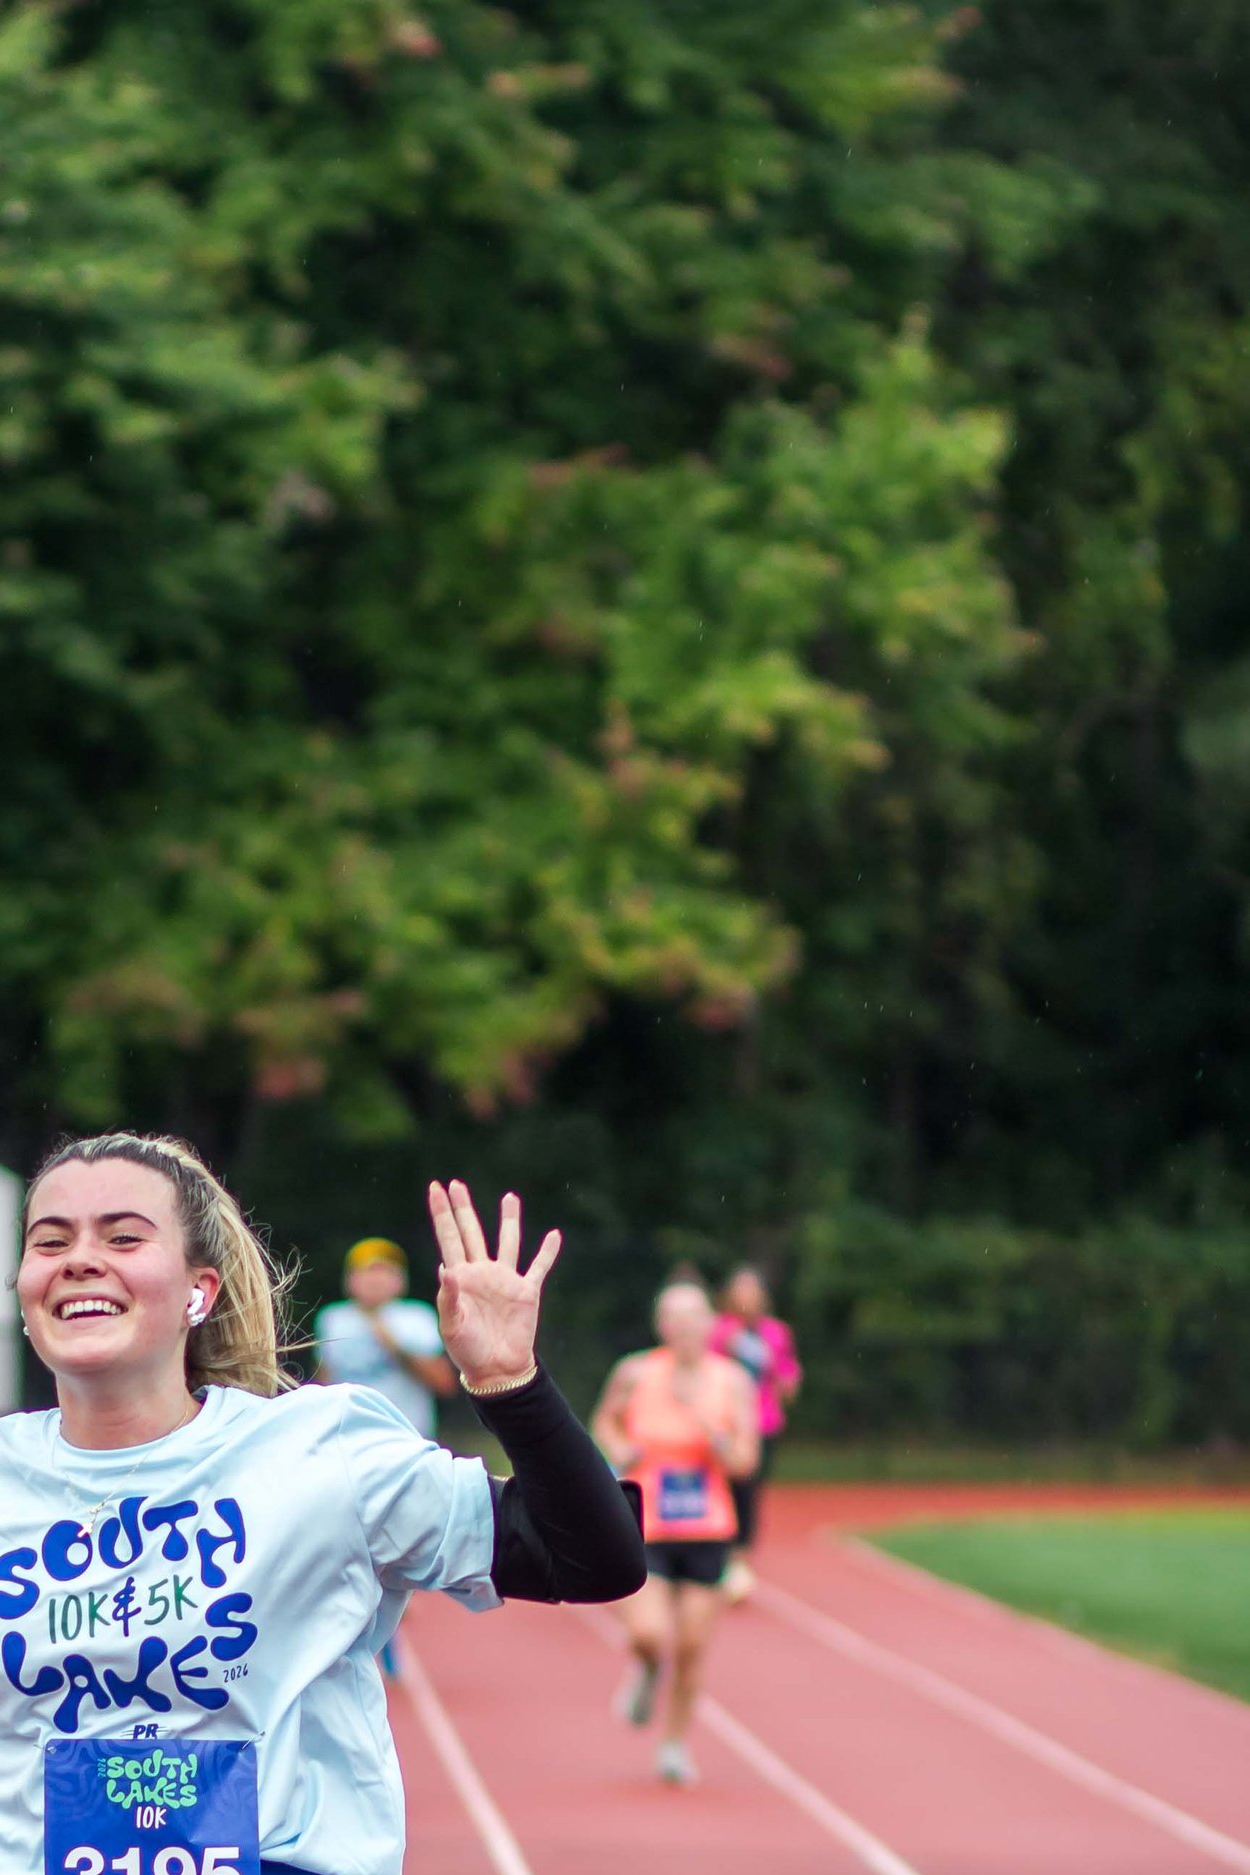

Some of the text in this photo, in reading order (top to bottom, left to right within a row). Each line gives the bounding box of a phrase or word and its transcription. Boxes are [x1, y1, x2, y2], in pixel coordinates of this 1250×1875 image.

[1, 1592, 258, 1734] LAKES
[223, 1663, 249, 1683] 2026
[132, 1723, 159, 1740] PR
[106, 1748, 198, 1785] SOUTH
[106, 1776, 198, 1809] LAKES
[136, 1806, 167, 1829] 10K
